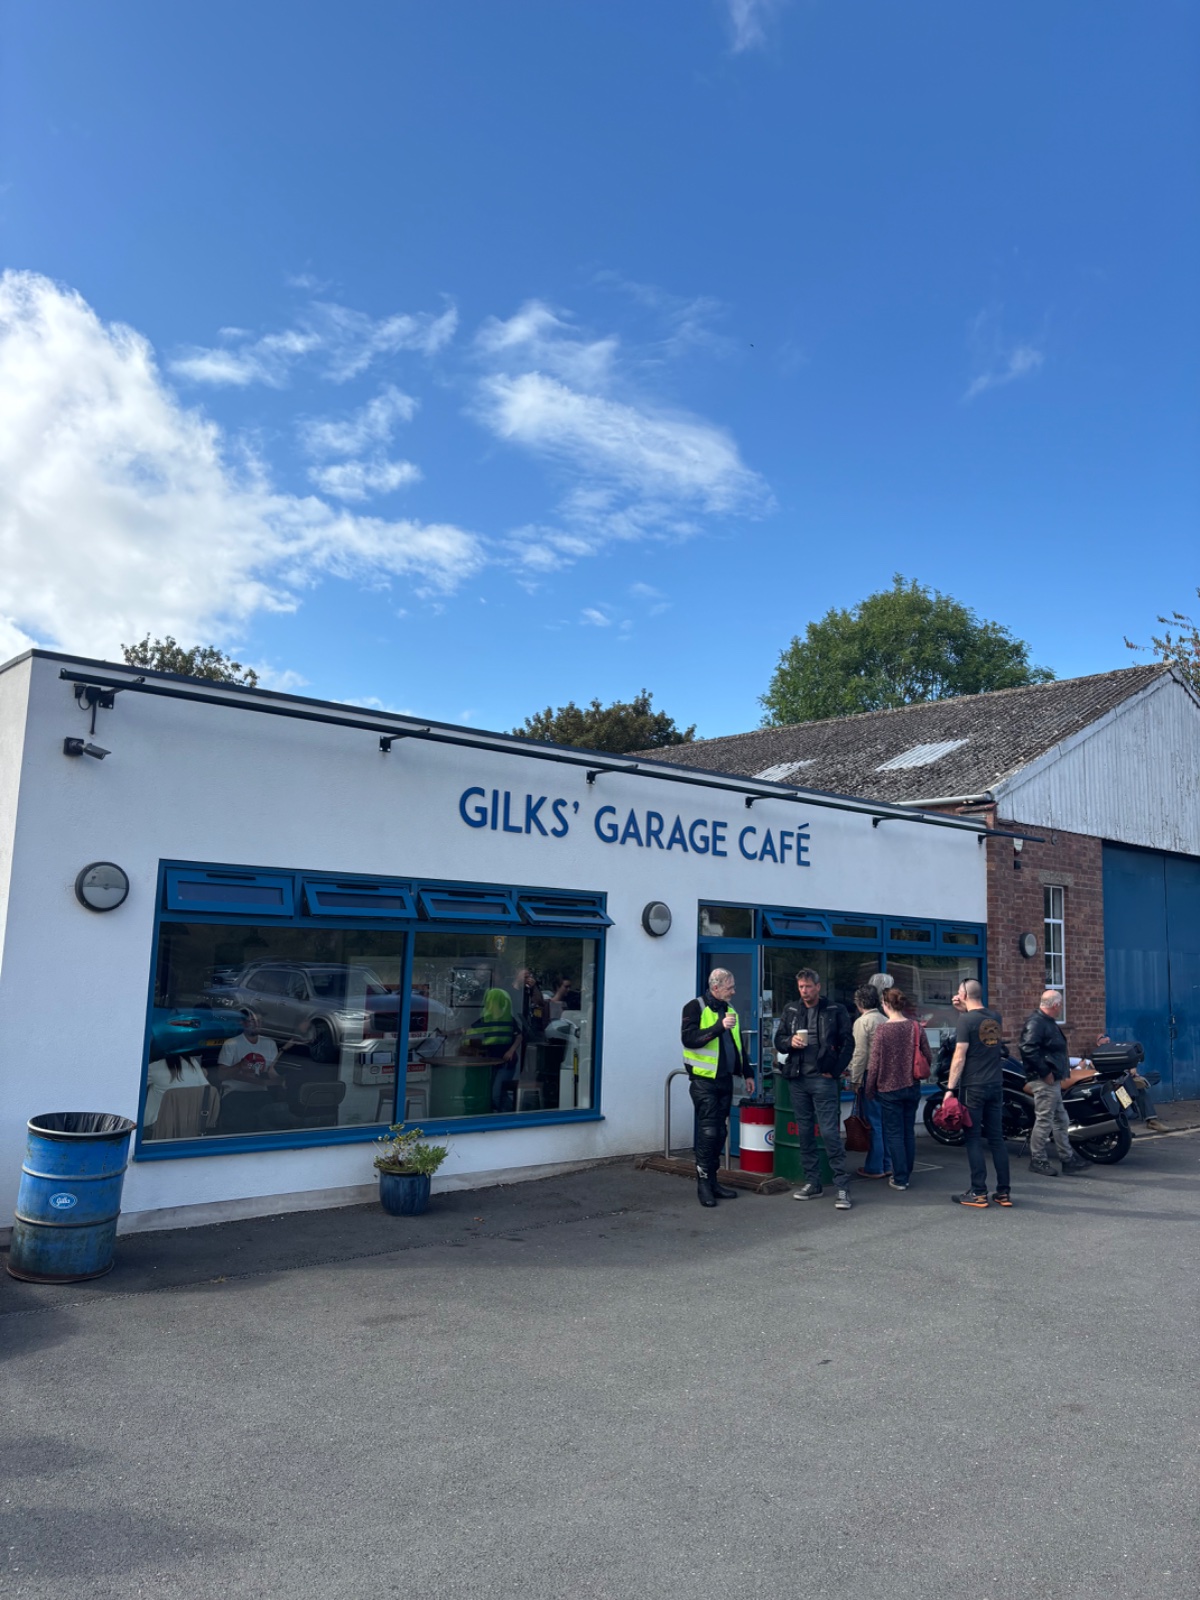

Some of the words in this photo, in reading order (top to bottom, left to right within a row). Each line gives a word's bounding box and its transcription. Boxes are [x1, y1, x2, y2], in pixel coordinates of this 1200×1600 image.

[459, 786, 580, 838] GILKS’
[594, 805, 728, 857] GARAGE
[738, 822, 811, 867] CAFÉ
